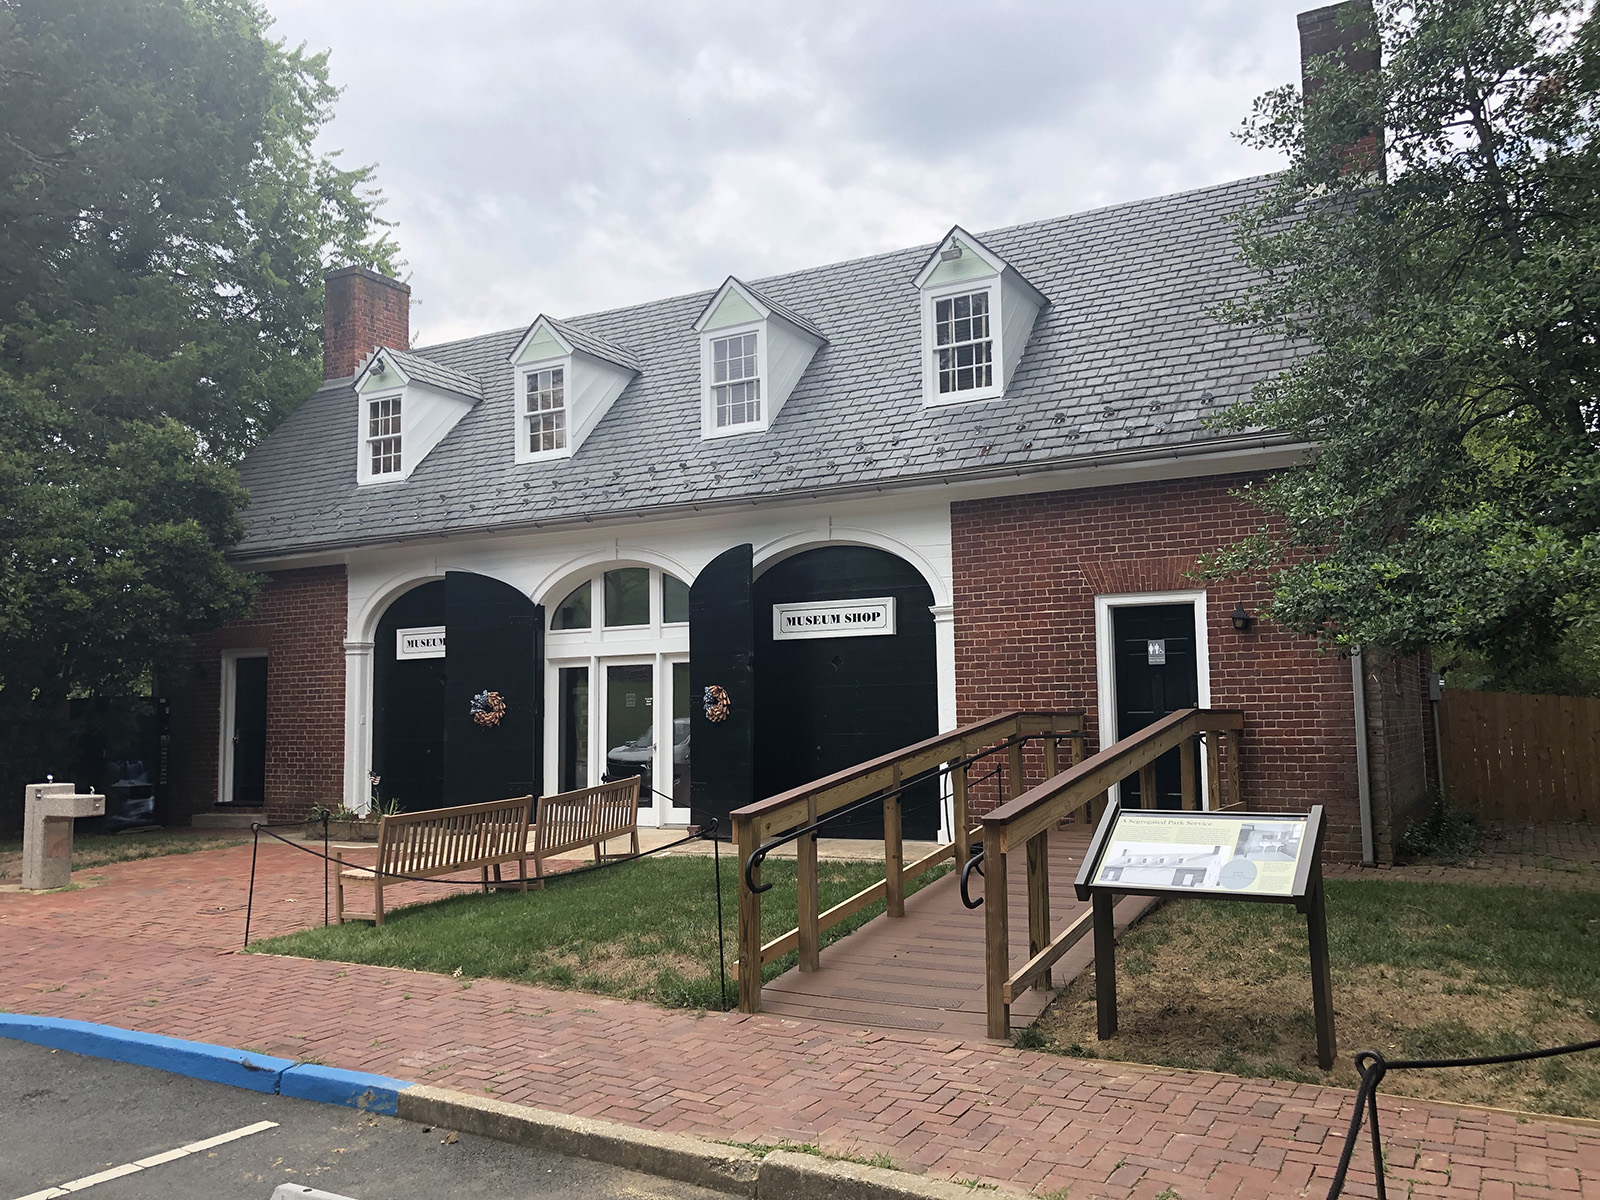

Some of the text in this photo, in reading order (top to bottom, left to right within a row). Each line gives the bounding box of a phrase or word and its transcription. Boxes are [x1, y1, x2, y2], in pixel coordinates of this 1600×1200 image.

[786, 612, 881, 626] MUSEUM SHOP
[407, 638, 446, 648] MUSEUM
